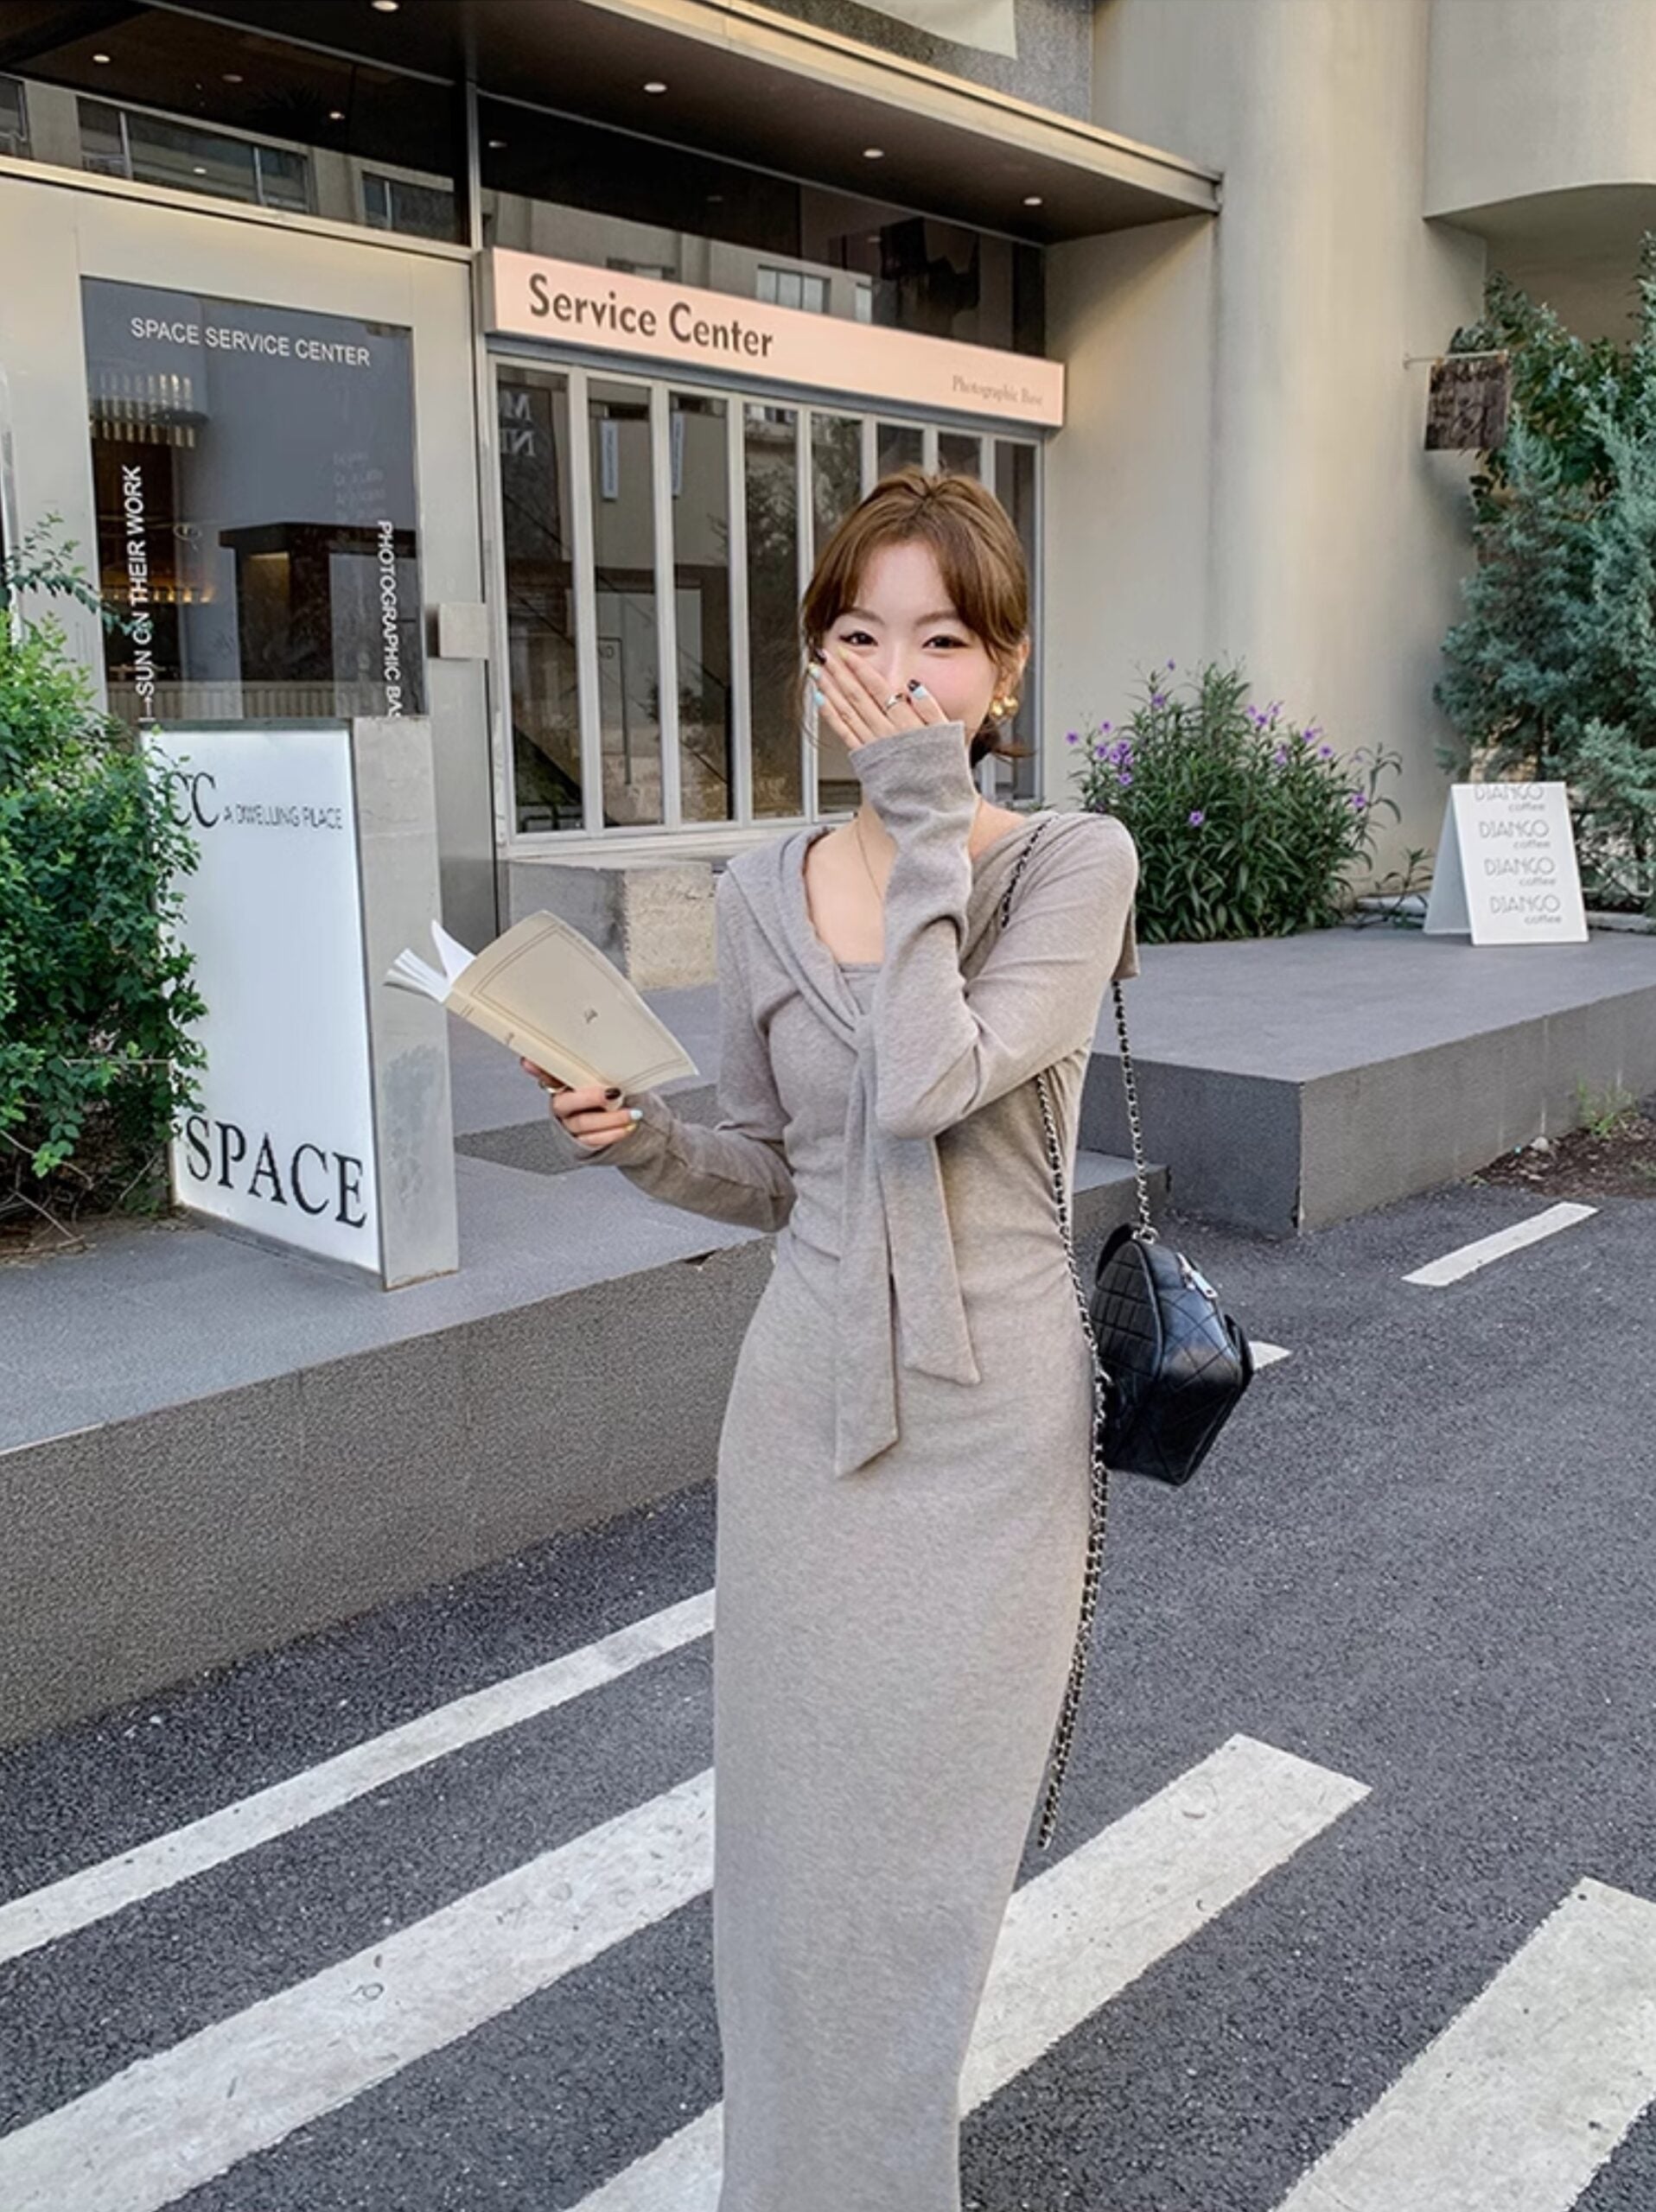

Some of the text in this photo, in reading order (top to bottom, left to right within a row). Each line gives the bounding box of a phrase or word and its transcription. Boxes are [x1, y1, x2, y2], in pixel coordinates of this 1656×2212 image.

[131, 317, 371, 366] SPACE SERVICE CENTER
[529, 273, 774, 357] Service Center
[122, 464, 155, 696] SUN ON THEIR WORK
[378, 520, 402, 681] PHOTOGRAPHIC
[224, 806, 233, 823] A
[236, 804, 299, 828] DWELLING
[303, 805, 343, 830] PLACE
[186, 1115, 368, 1229] SPACE
